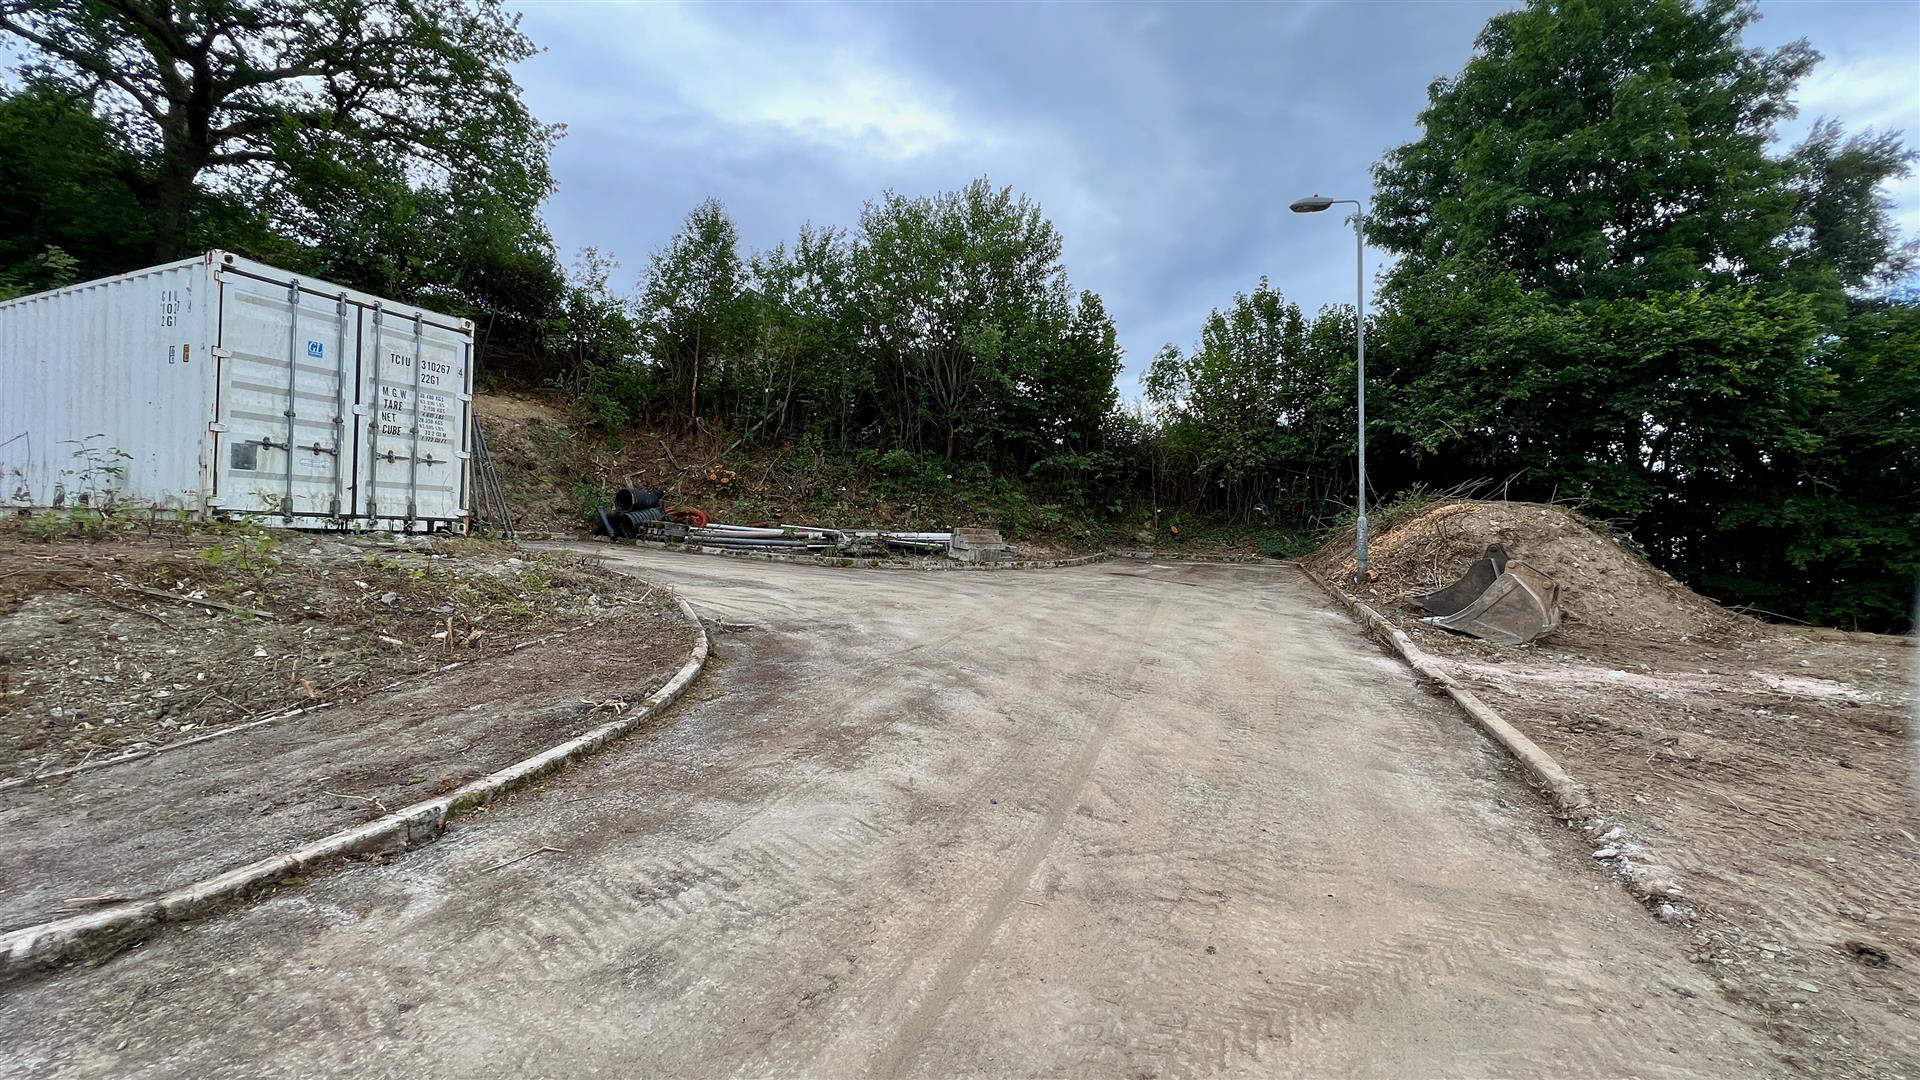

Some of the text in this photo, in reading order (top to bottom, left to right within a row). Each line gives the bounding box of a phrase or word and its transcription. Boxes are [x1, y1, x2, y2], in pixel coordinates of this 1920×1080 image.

[390, 353, 411, 367] TCIU
[421, 360, 451, 375] 310267
[421, 374, 440, 386] 22G1
[383, 399, 403, 411] TARE
[381, 411, 396, 423] NET
[382, 424, 402, 436] CUBE
